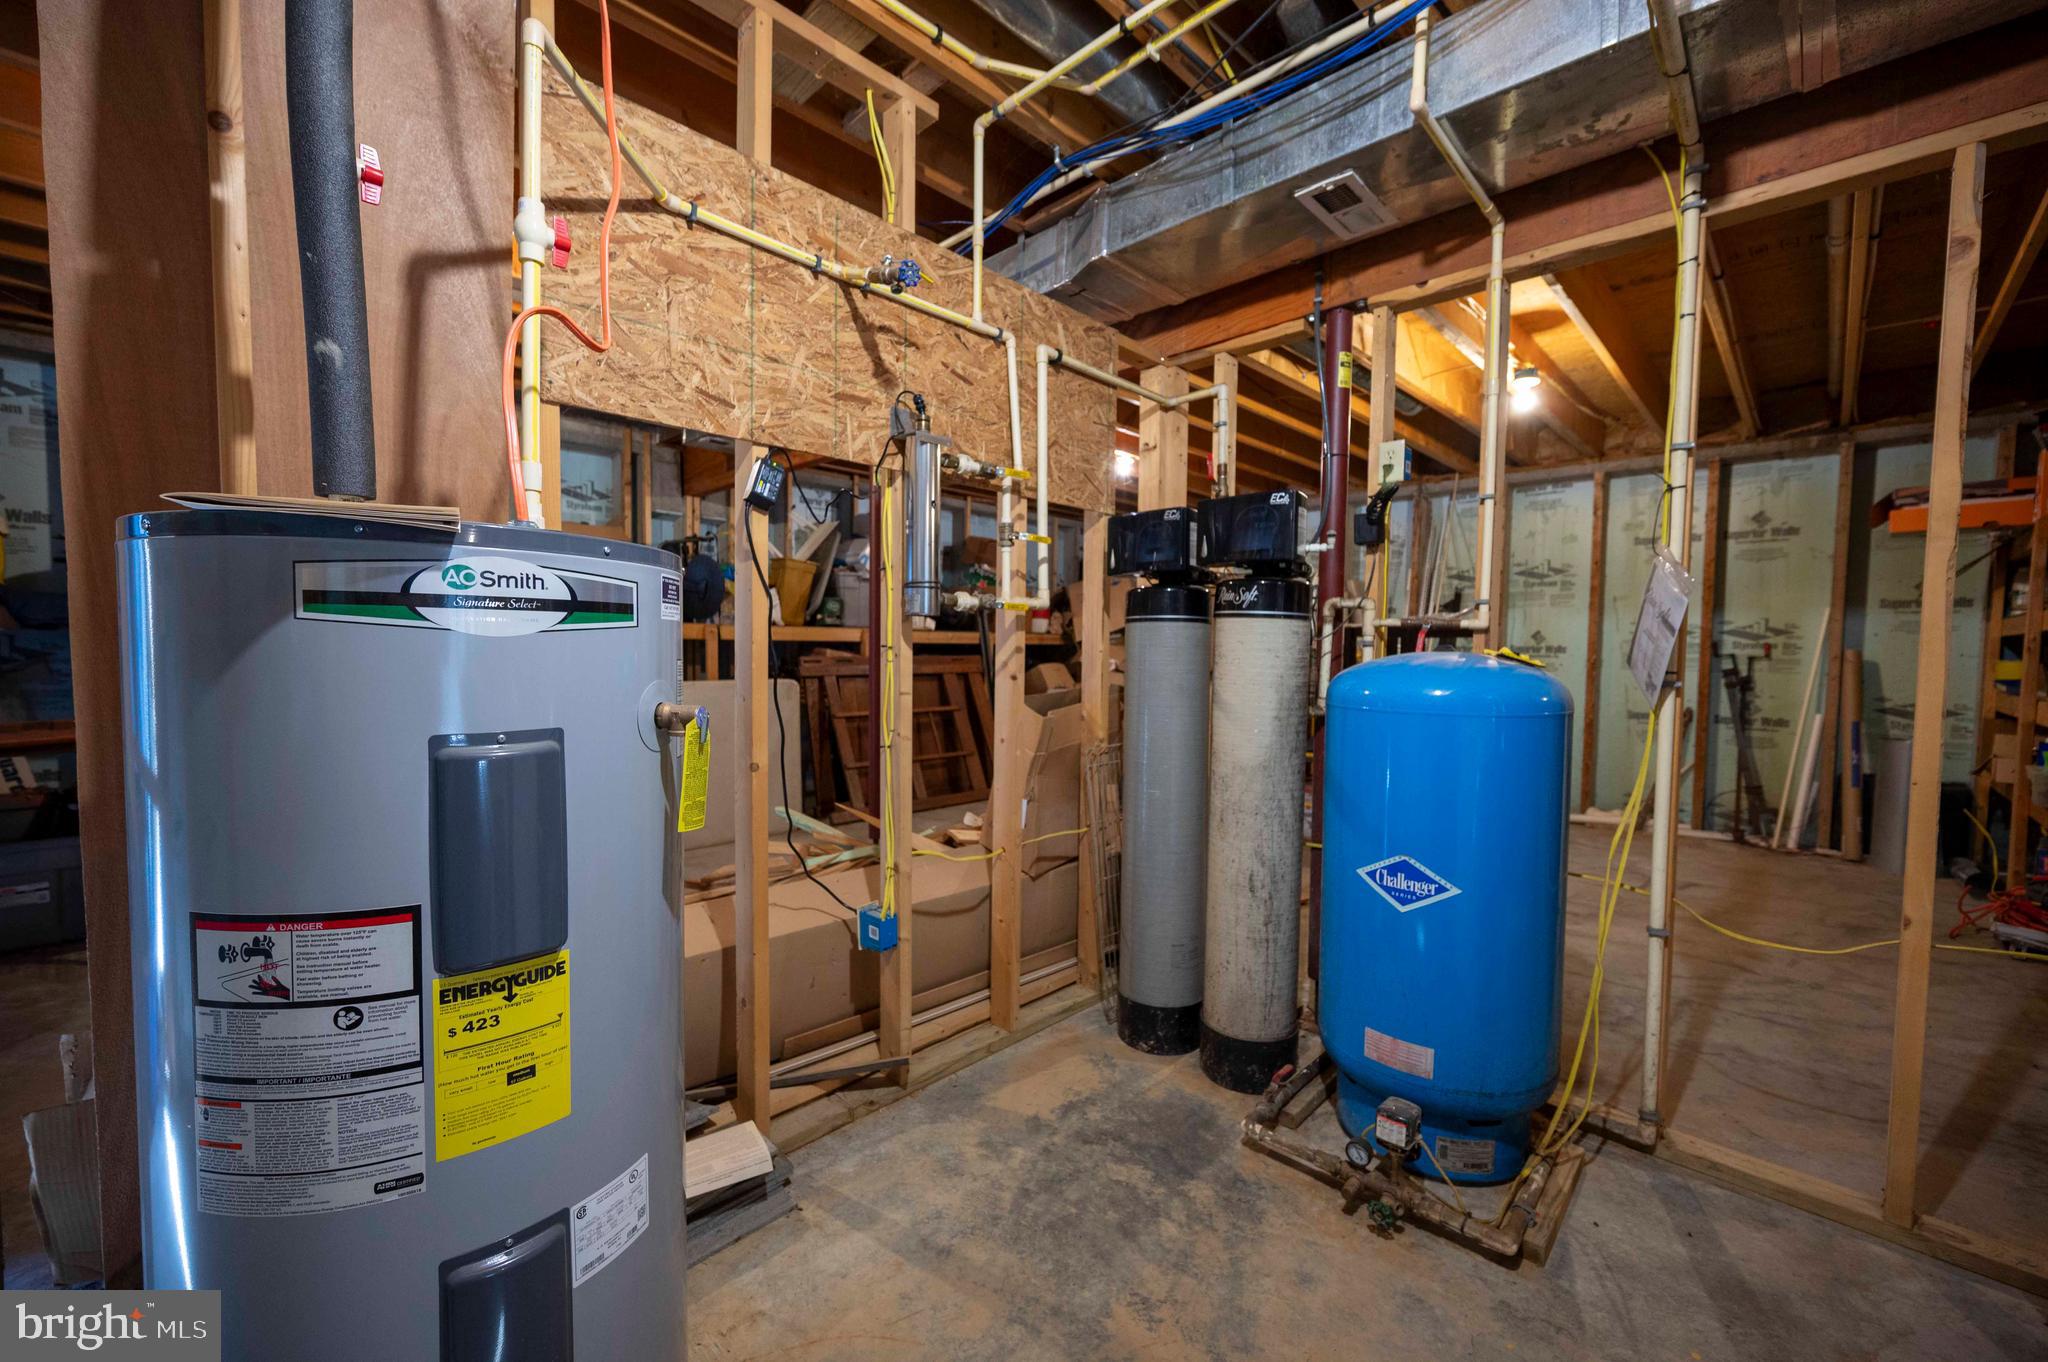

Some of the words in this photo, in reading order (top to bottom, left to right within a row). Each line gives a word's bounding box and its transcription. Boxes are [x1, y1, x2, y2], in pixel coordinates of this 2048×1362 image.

[453, 597, 505, 608] Signature
[1376, 868, 1439, 897] Challenger
[279, 922, 324, 931] DANGER
[439, 960, 567, 1005] ENERGYGUIDE
[448, 1028, 457, 1038] $
[462, 1014, 500, 1033] 423
[513, 1052, 535, 1061] Rating
